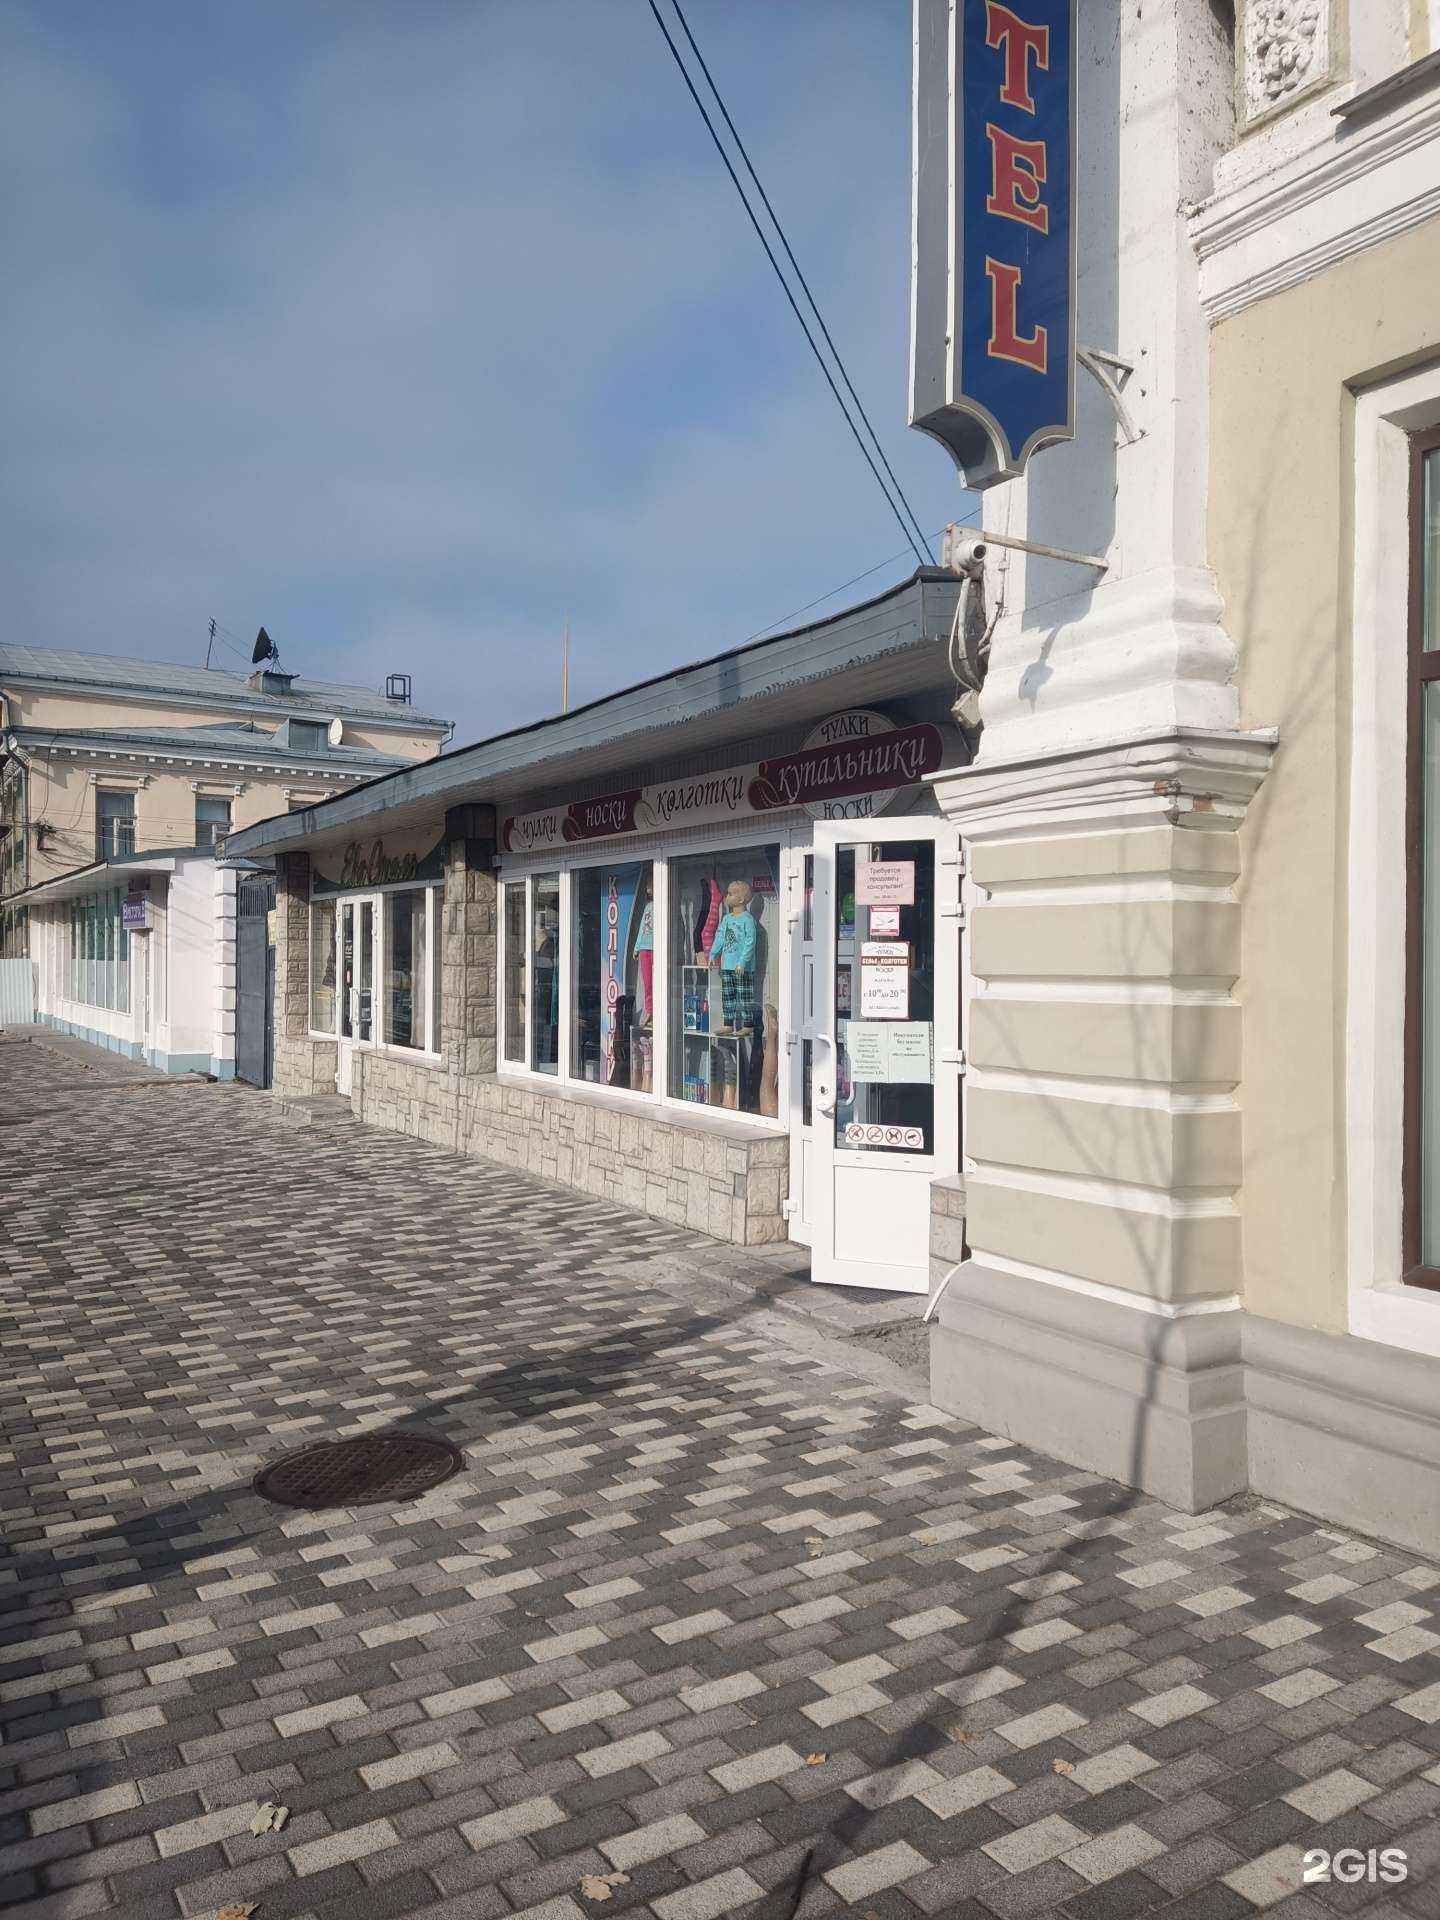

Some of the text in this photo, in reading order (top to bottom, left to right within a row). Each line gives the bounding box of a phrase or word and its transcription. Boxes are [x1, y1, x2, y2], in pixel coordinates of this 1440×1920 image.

[821, 715, 870, 744] ЧУЛКИ
[656, 775, 744, 822] колготки
[777, 736, 927, 804] купальники
[823, 795, 874, 820] НОСКИ
